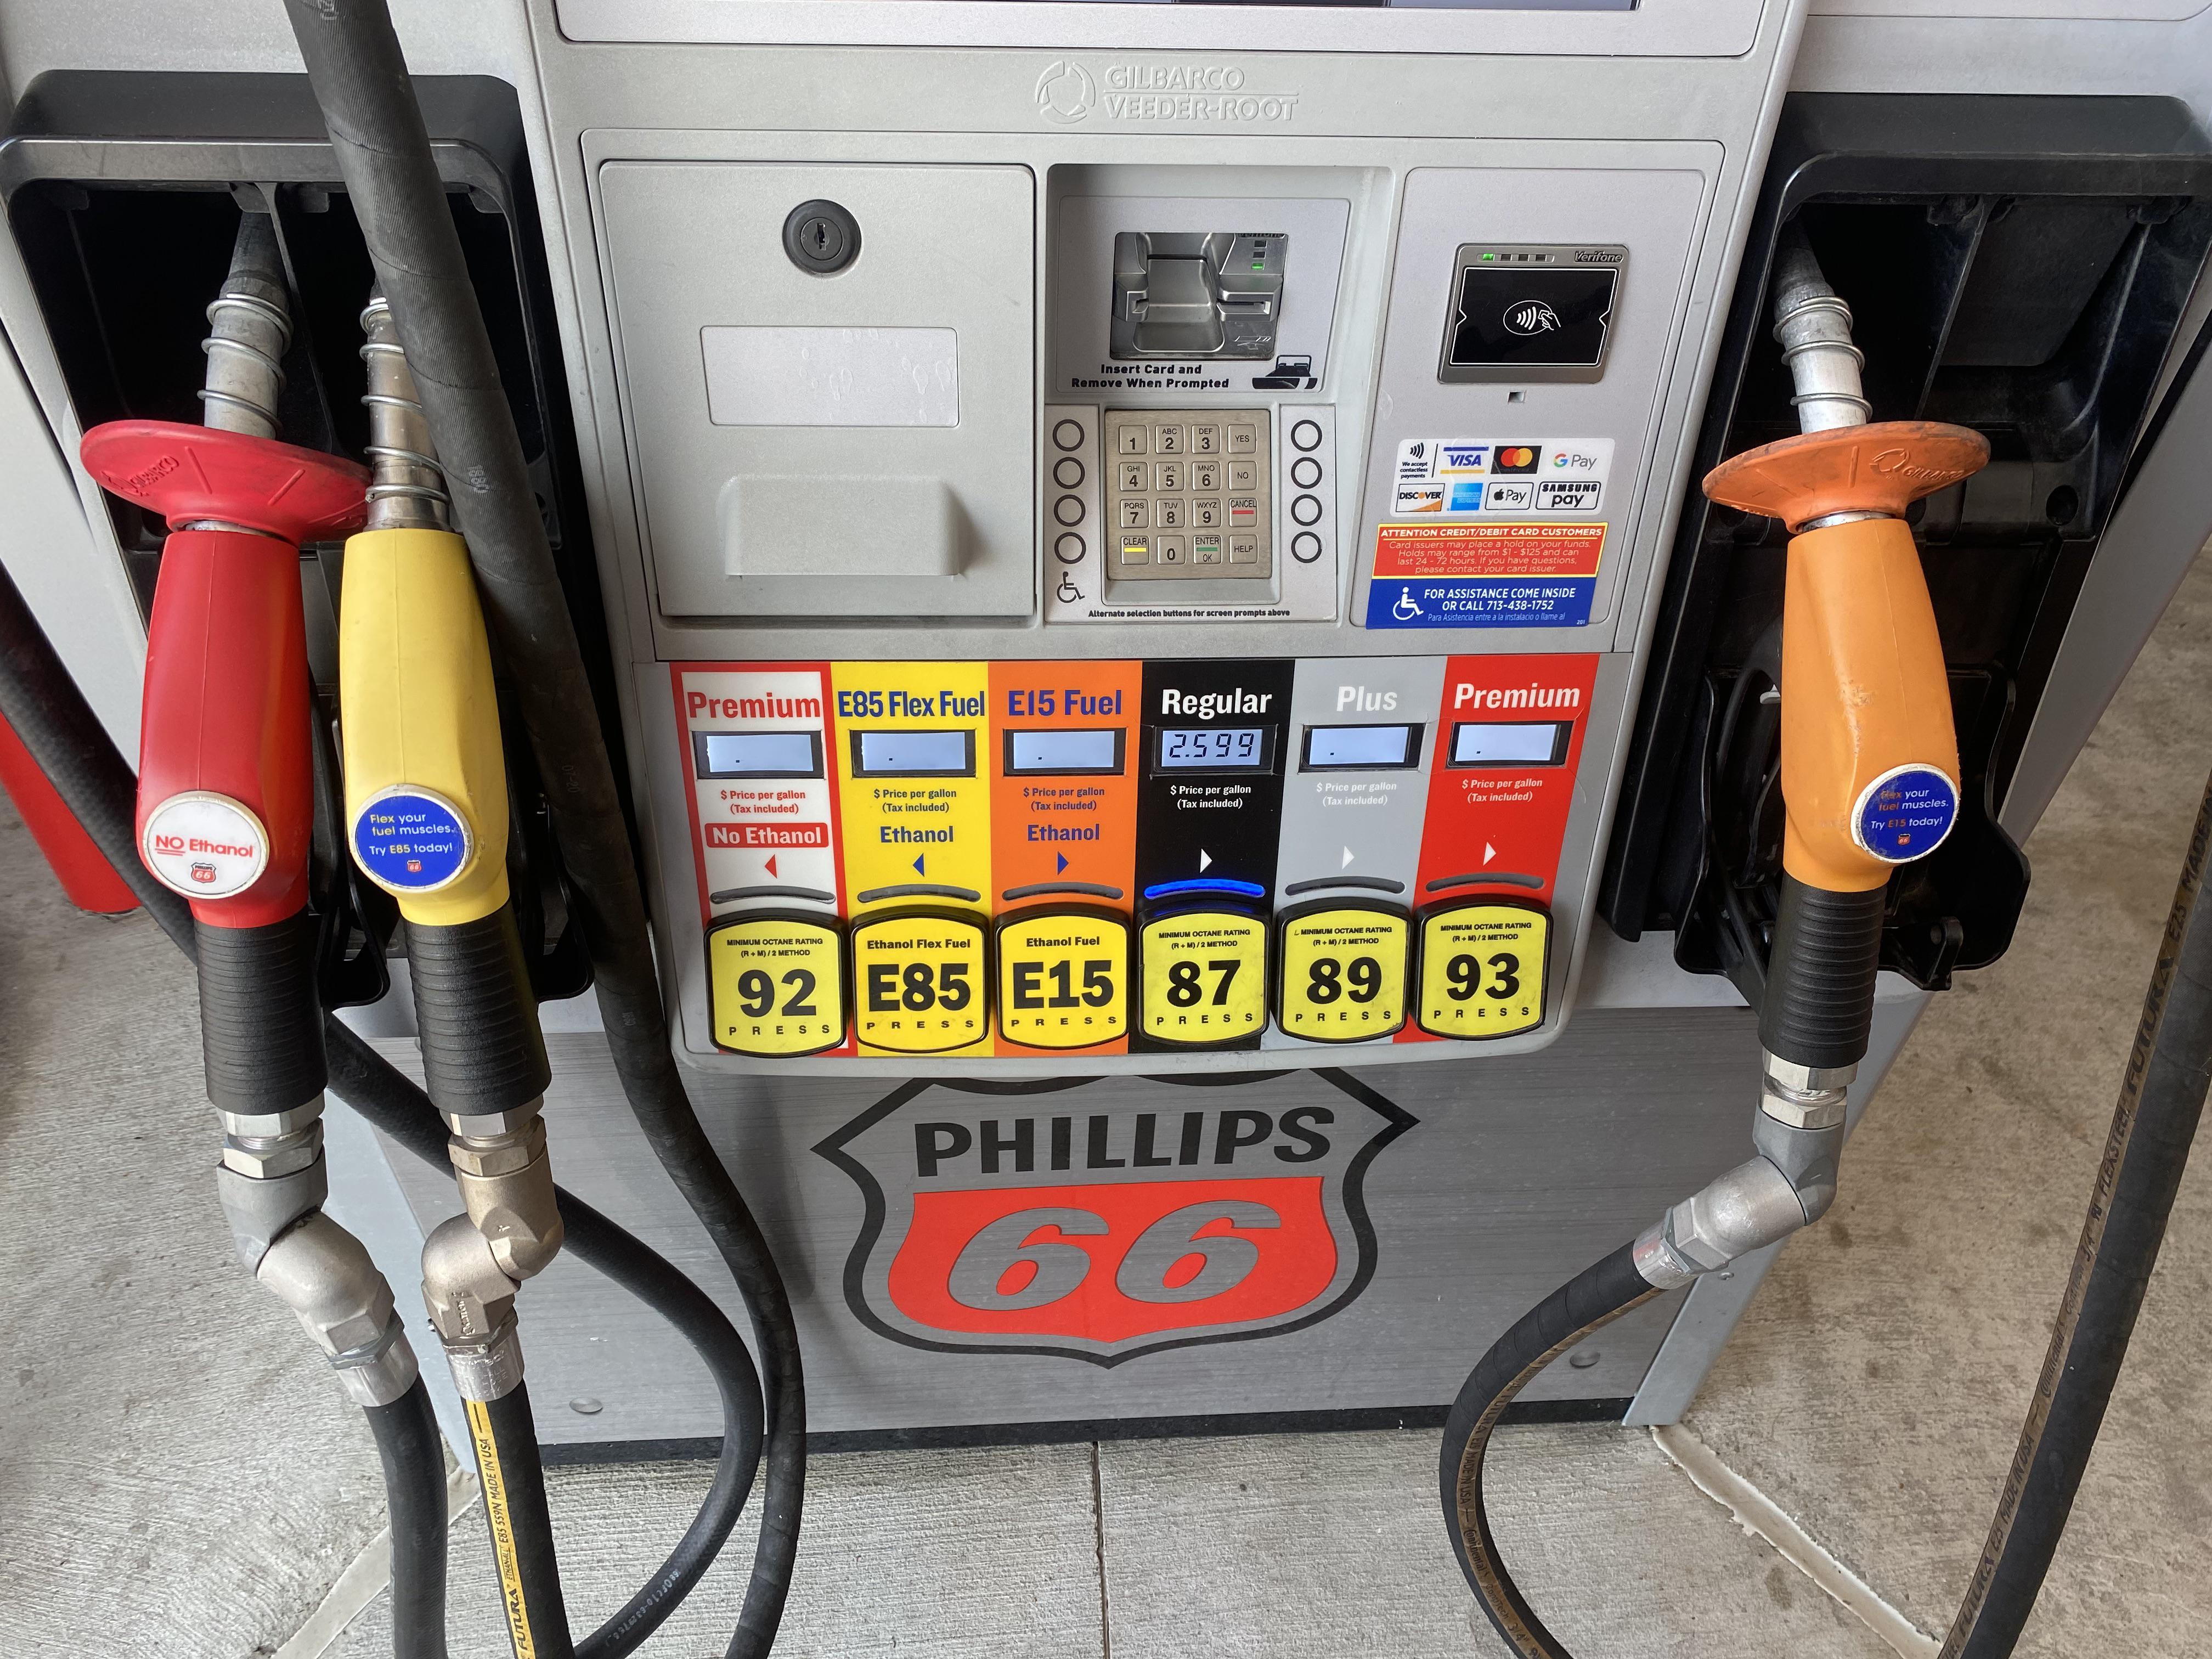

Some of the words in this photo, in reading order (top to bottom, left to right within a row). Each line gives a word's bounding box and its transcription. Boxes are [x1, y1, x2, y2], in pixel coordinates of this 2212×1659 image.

[1105, 66, 1244, 91] GILBARCO
[1104, 96, 1299, 121] VEEDER-ROOT
[1575, 250, 1623, 262] Verifone
[1101, 364, 1140, 374] Insert
[1144, 364, 1174, 374] Card
[1178, 364, 1201, 374] and
[1071, 378, 1123, 388] Remove
[1127, 378, 1160, 388] When
[1166, 379, 1229, 390] Prompted
[1130, 438, 1136, 450] 1
[1165, 438, 1174, 450] 2
[1201, 438, 1210, 450] 3
[1447, 455, 1481, 466] VISA
[1571, 454, 1597, 470] Pay
[1129, 476, 1138, 487] 4
[1166, 475, 1174, 487] 5
[1202, 475, 1210, 487] 6
[1542, 484, 1597, 492] SAMSUNG
[1505, 490, 1527, 504] Pay
[1551, 495, 1584, 507] pay
[1130, 512, 1138, 524] 7
[1166, 512, 1175, 524] 8
[1203, 511, 1211, 523] 9
[1440, 528, 1507, 537] CREDIT/DEBIT
[1469, 541, 1493, 549] place
[1167, 549, 1176, 561] 0
[1531, 556, 1577, 565] questions,
[1415, 565, 1444, 574] please
[1424, 589, 1444, 599] FOR
[1447, 589, 1509, 599] ASSISTANCE
[1511, 589, 1540, 598] COME
[1542, 588, 1576, 597] INSIDE
[1442, 601, 1455, 611] OR
[1459, 601, 1484, 611] CALL
[1487, 601, 1554, 610] 713-438-1752
[1234, 610, 1265, 618] prompts
[1336, 686, 1398, 712] Plus
[1454, 683, 1580, 708] Premium
[687, 692, 821, 718] Premium
[838, 691, 883, 717] E85
[889, 691, 934, 716] Flex
[940, 691, 985, 716] Fuel
[1008, 690, 1055, 716] E15
[1065, 690, 1121, 715] Fuel
[1162, 688, 1272, 720] Regular
[1180, 785, 1203, 795] Price
[1205, 787, 1221, 797] per
[1223, 785, 1251, 797] gallon
[1905, 789, 1929, 799] your
[1177, 799, 1197, 809] (Tax
[1200, 797, 1243, 809] included)
[1902, 799, 1948, 809] muscles.
[370, 814, 394, 823] Flex
[398, 814, 426, 825] your
[1871, 821, 1885, 830] Try
[1909, 816, 1943, 826] today!
[373, 826, 395, 836] fuel
[400, 824, 454, 834] muscles.
[713, 827, 740, 845] No
[746, 827, 821, 845] Ethanol
[880, 826, 953, 843] Ethanol
[1028, 824, 1100, 842] Ethanol
[156, 835, 184, 849] NO
[189, 839, 253, 857] Ethanol
[369, 845, 386, 856] Try
[390, 844, 410, 854] E85
[414, 843, 453, 854] today!
[867, 939, 913, 950] Ethanol
[917, 939, 941, 949] Flex
[945, 939, 970, 949] Fuel
[1026, 937, 1071, 947] Ethanol
[1075, 936, 1100, 946] Fuel
[1306, 957, 1382, 1005] 89
[1446, 952, 1520, 1001] 93
[868, 963, 971, 1012] E85
[1013, 960, 1114, 1009] E15
[1167, 960, 1241, 1007] 87
[738, 969, 817, 1018] 92
[915, 1107, 1334, 1177] PHILLIPS
[947, 1200, 1282, 1311] 66
[479, 1438, 492, 1458] USA
[483, 1460, 494, 1470] IN
[487, 1471, 500, 1500] MADE
[493, 1502, 505, 1526] 559N
[498, 1527, 509, 1543] E85
[509, 1588, 528, 1650] FUTURA
